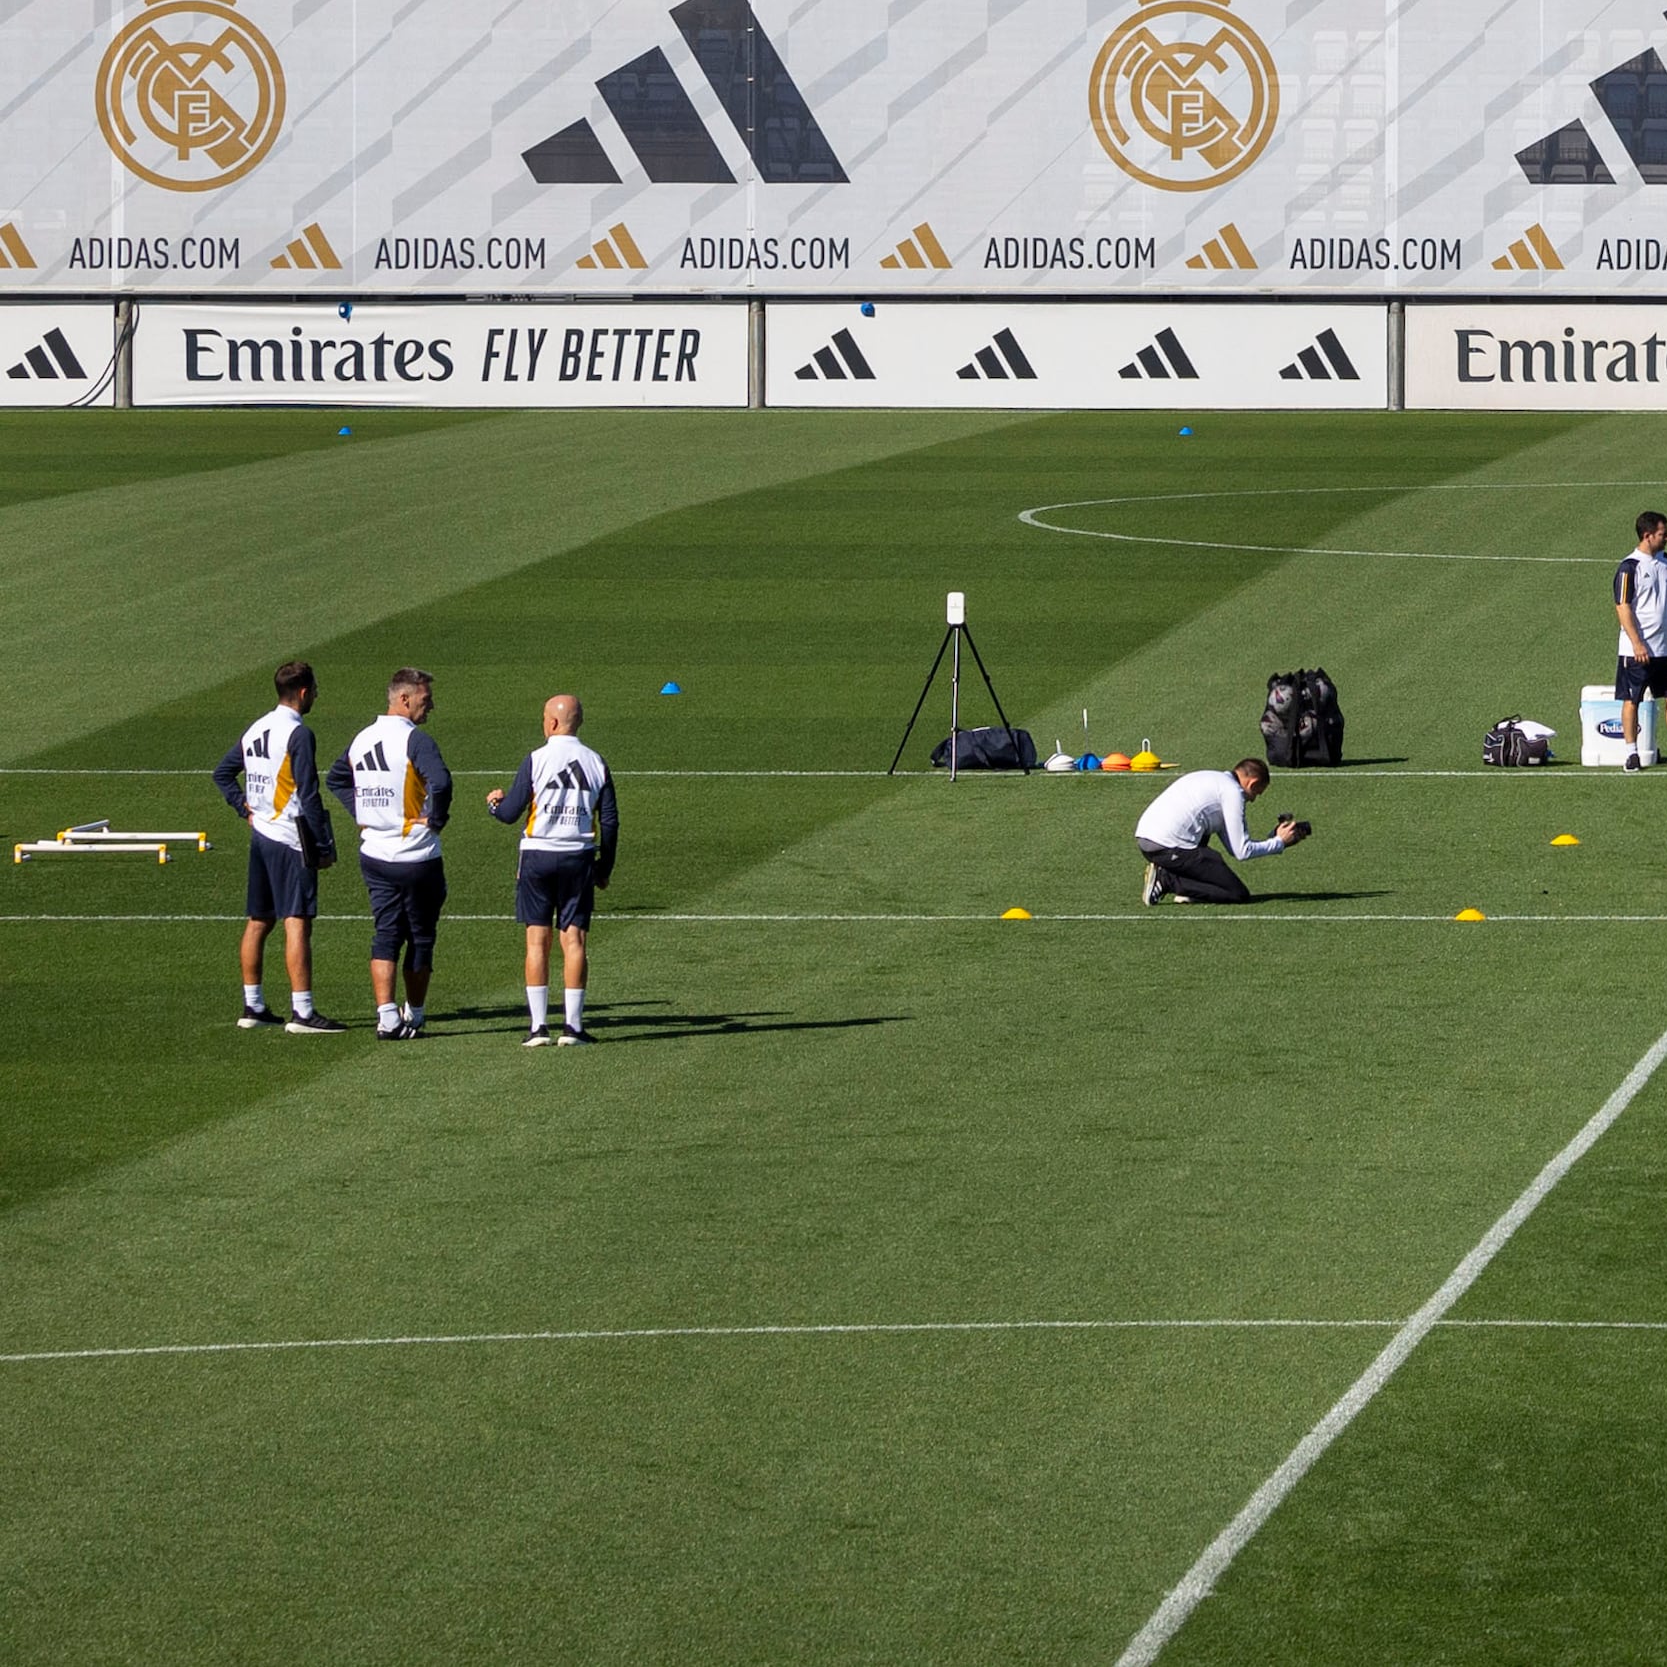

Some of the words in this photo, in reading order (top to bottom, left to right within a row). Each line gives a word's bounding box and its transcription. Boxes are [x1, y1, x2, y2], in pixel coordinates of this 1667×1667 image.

[70, 238, 239, 270] ADIDAS.COM
[375, 238, 545, 270] ADIDAS.COM
[681, 238, 849, 270] ADIDAS.COM
[984, 238, 1155, 270] ADIDAS.COM
[1290, 239, 1461, 271] ADIDAS.COM
[185, 327, 454, 383] Emirates
[482, 328, 549, 383] FLY
[561, 329, 700, 383] BETTER
